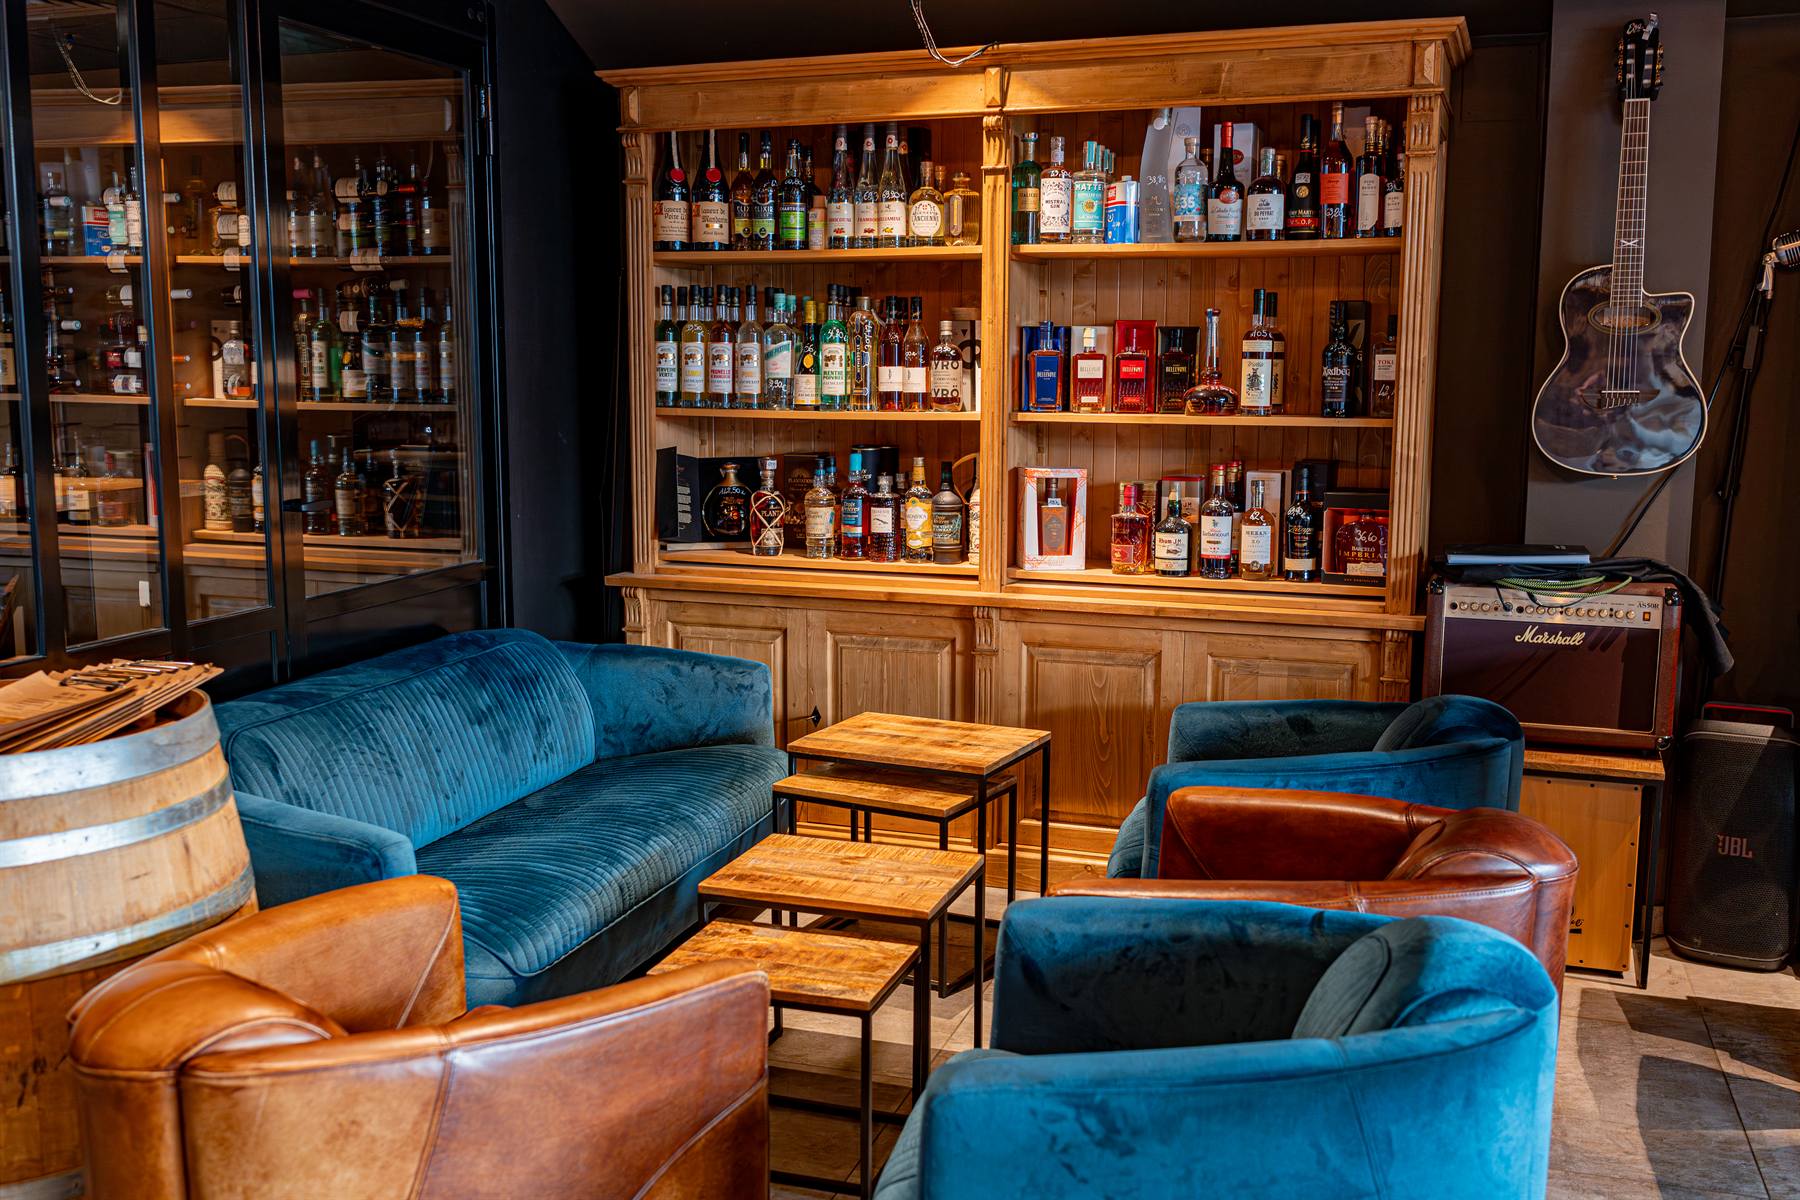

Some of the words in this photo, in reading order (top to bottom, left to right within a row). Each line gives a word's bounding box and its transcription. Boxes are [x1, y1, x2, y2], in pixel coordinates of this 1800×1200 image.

[1354, 529, 1378, 543] 36,60
[1514, 625, 1586, 647] Marshall
[1714, 834, 1753, 859] JBL
